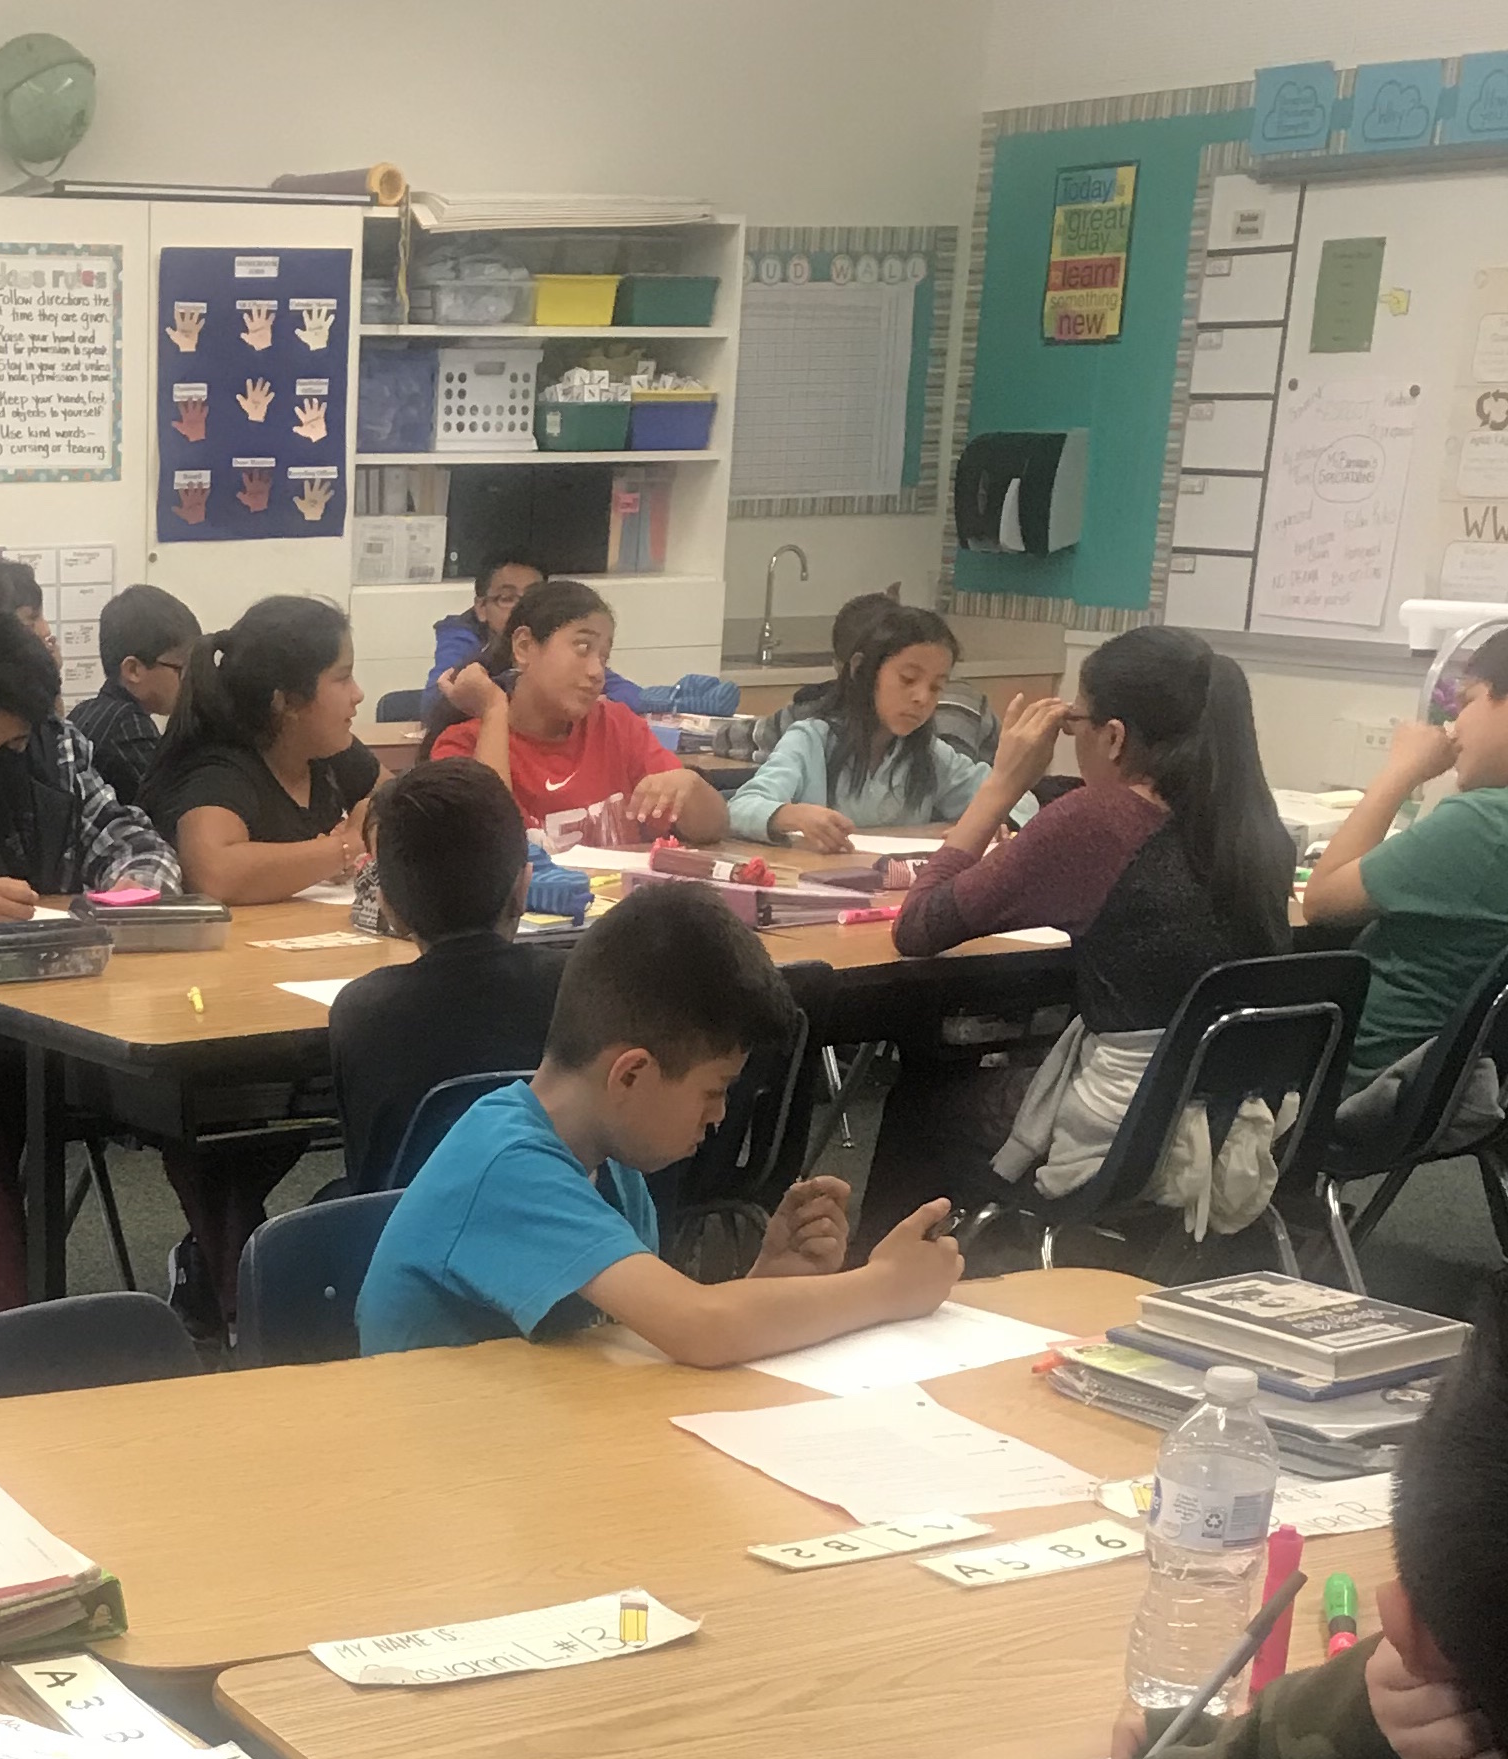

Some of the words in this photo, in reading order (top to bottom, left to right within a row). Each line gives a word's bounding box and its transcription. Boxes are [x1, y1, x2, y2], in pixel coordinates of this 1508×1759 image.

[1060, 174, 1114, 204] Today
[1067, 201, 1127, 240] great
[1077, 228, 1112, 254] day
[833, 260, 922, 280] WALL
[1062, 260, 1116, 289] learn
[37, 290, 90, 306] directions
[93, 293, 112, 307] the
[1050, 292, 1119, 311] something
[11, 307, 34, 322] time
[37, 308, 58, 328] they
[60, 312, 78, 323] are
[1059, 311, 1106, 336] new
[27, 331, 49, 345] your
[52, 331, 75, 343] hand
[77, 329, 96, 344] and
[24, 359, 35, 371] in
[36, 360, 56, 374] your
[31, 394, 53, 410] your
[11, 407, 47, 422] objects
[0, 424, 23, 439] Use
[27, 426, 51, 438] kind
[10, 443, 50, 459] cursing
[51, 443, 62, 453] or
[333, 1640, 369, 1661] MY
[372, 1632, 432, 1655] NAME
